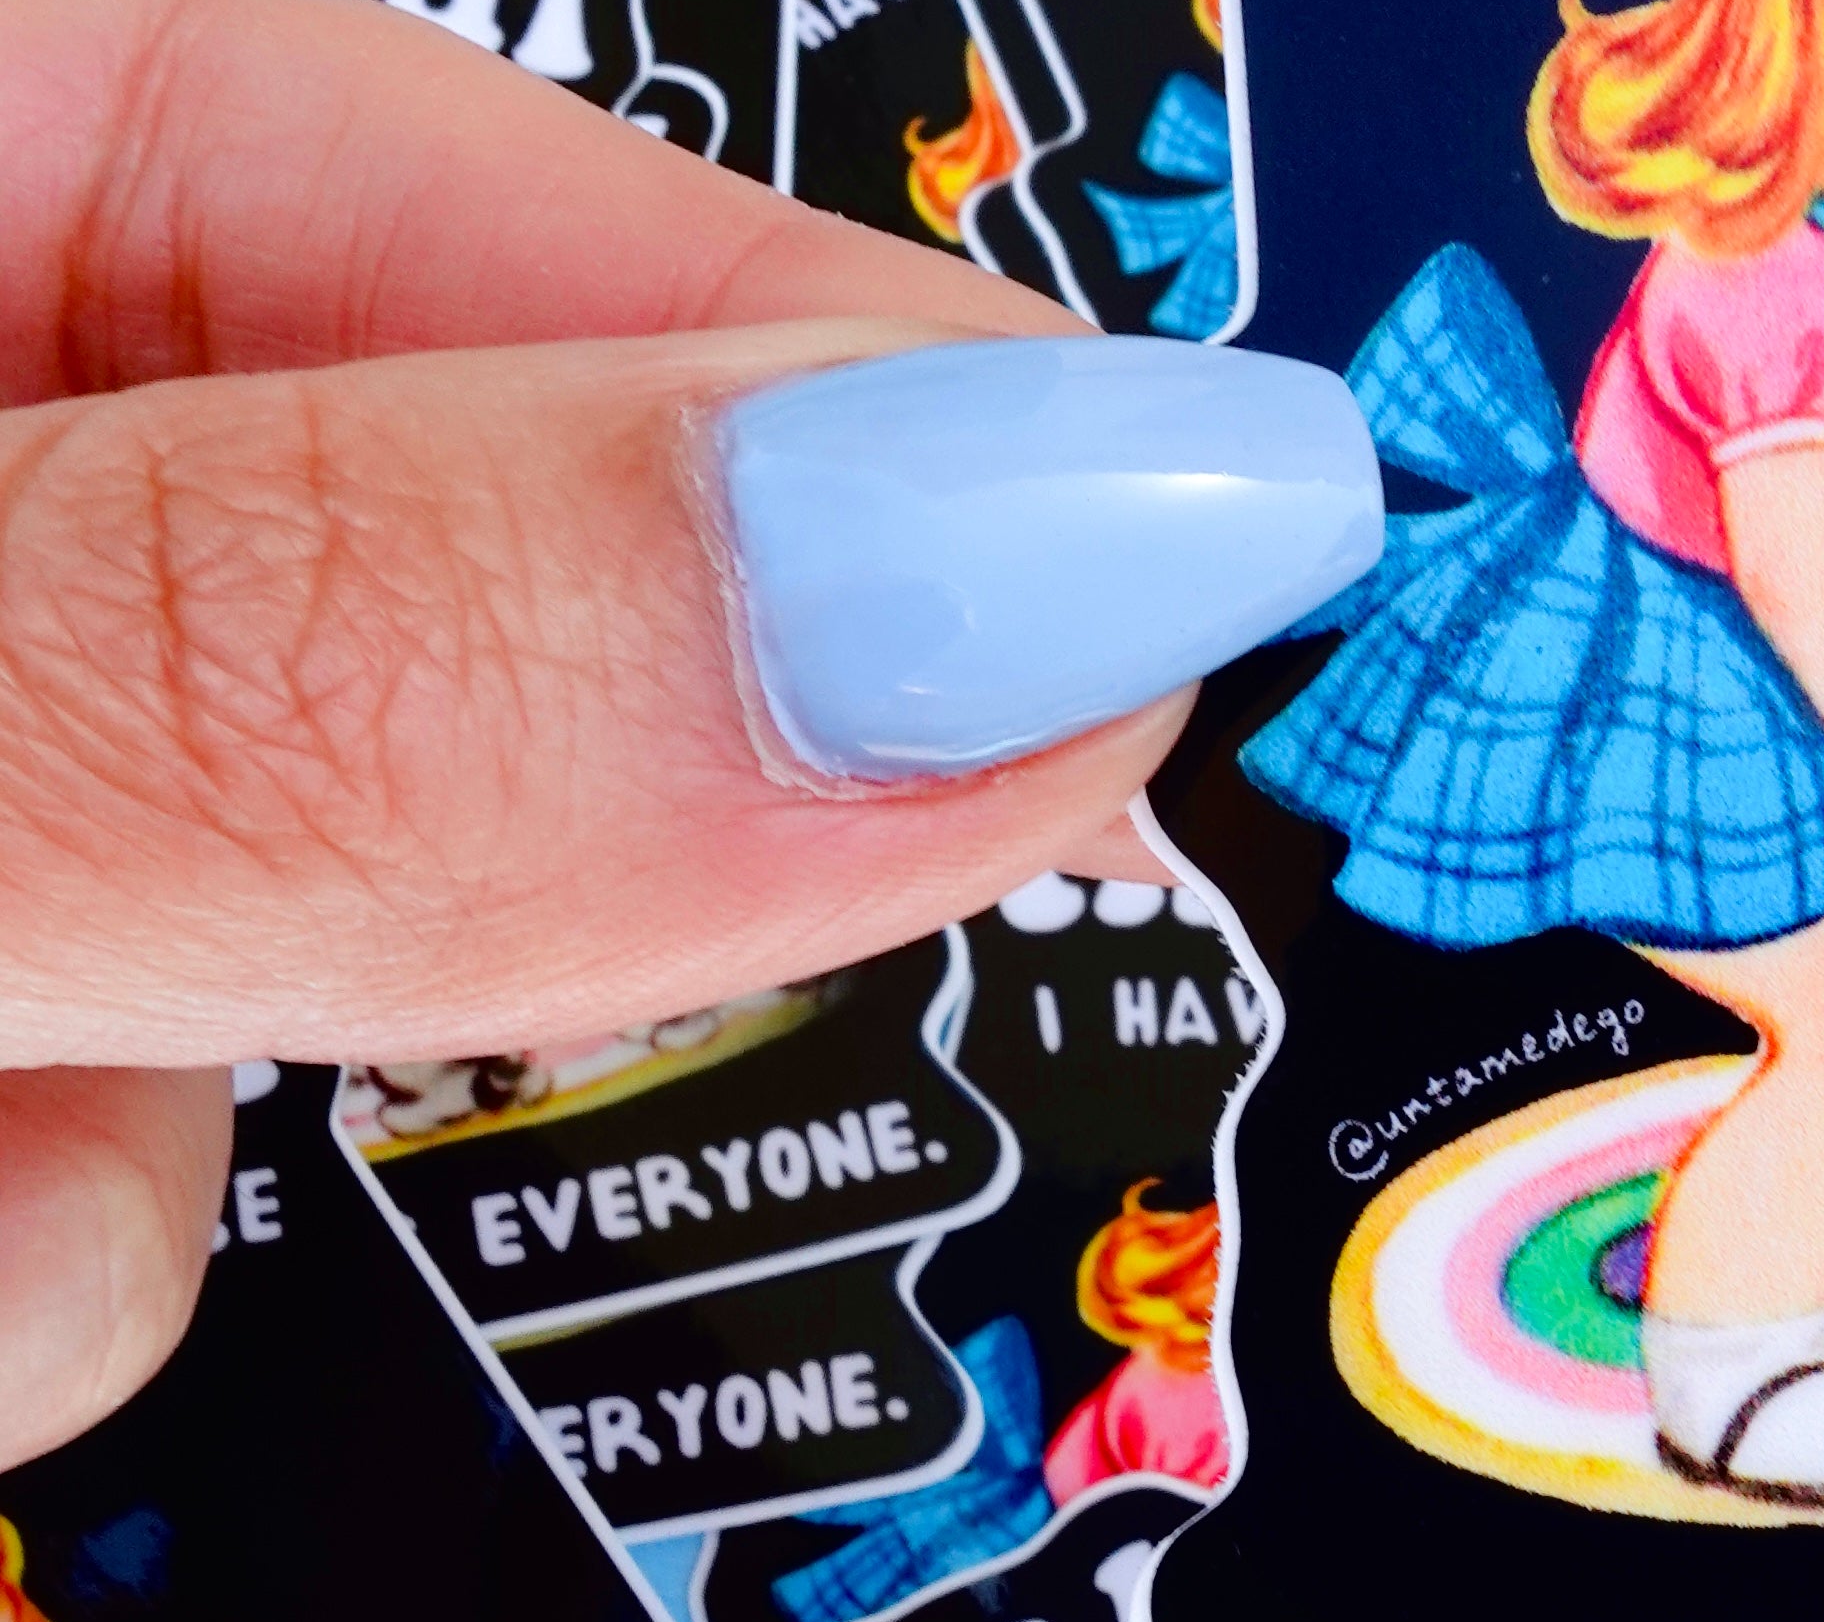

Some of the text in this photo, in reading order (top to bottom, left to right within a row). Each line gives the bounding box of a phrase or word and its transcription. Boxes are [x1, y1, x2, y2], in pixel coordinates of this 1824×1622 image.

[1033, 983, 1063, 1056] I
[1327, 998, 1646, 1183] @untamedego
[471, 1100, 949, 1267] EVERYONE.
